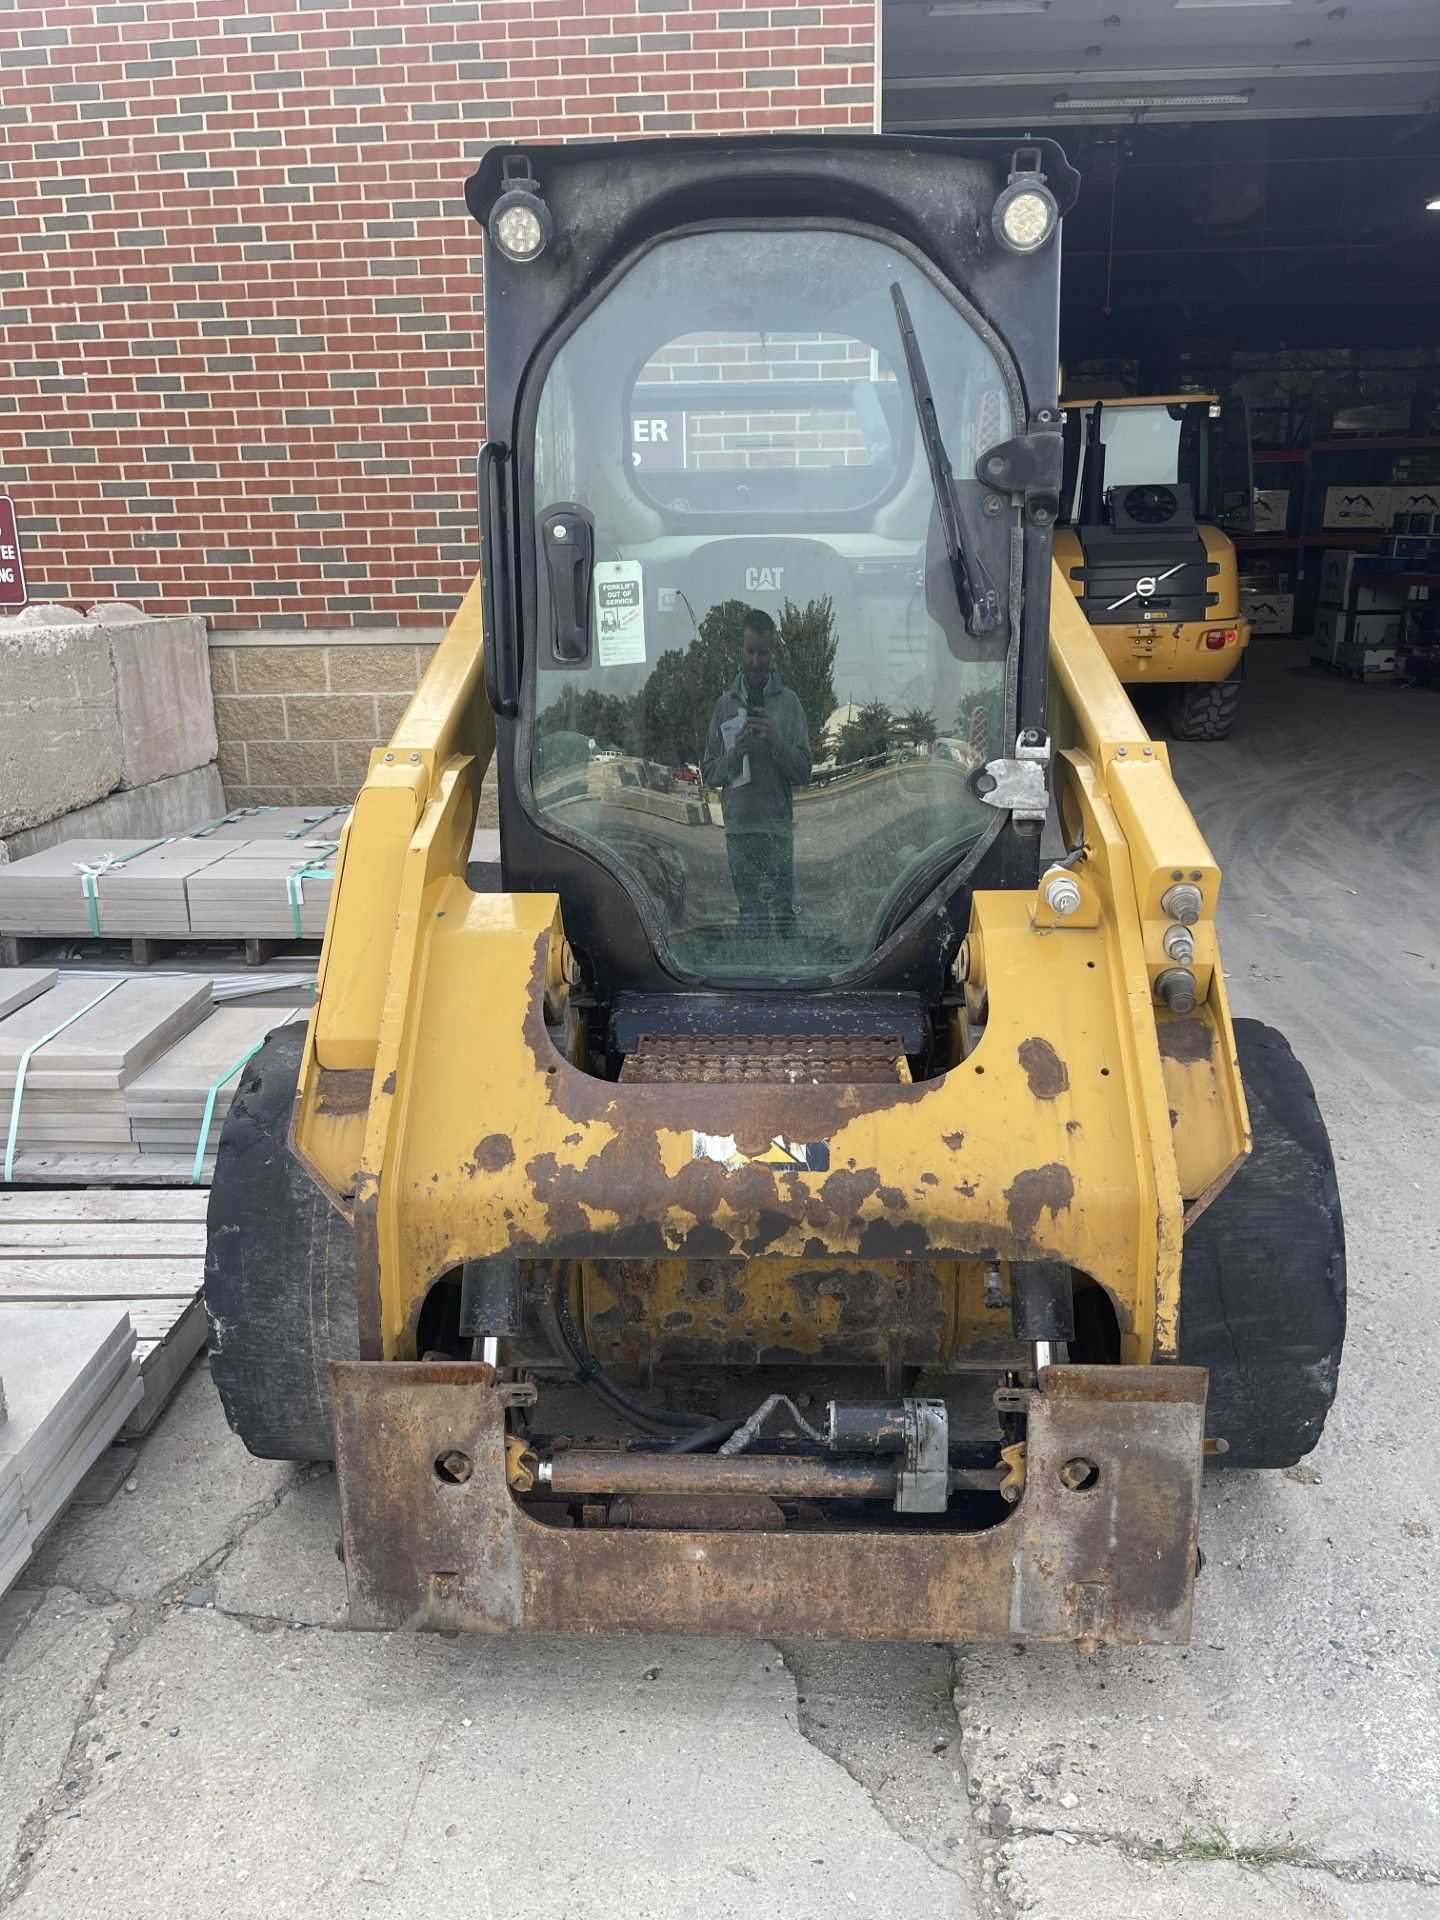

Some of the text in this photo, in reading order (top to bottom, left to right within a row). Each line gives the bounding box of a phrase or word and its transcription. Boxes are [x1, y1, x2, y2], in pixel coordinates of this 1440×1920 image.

[745, 567, 784, 591] CAT
[603, 582, 635, 591] FORKLIFT
[606, 598, 633, 606] SERVICE
